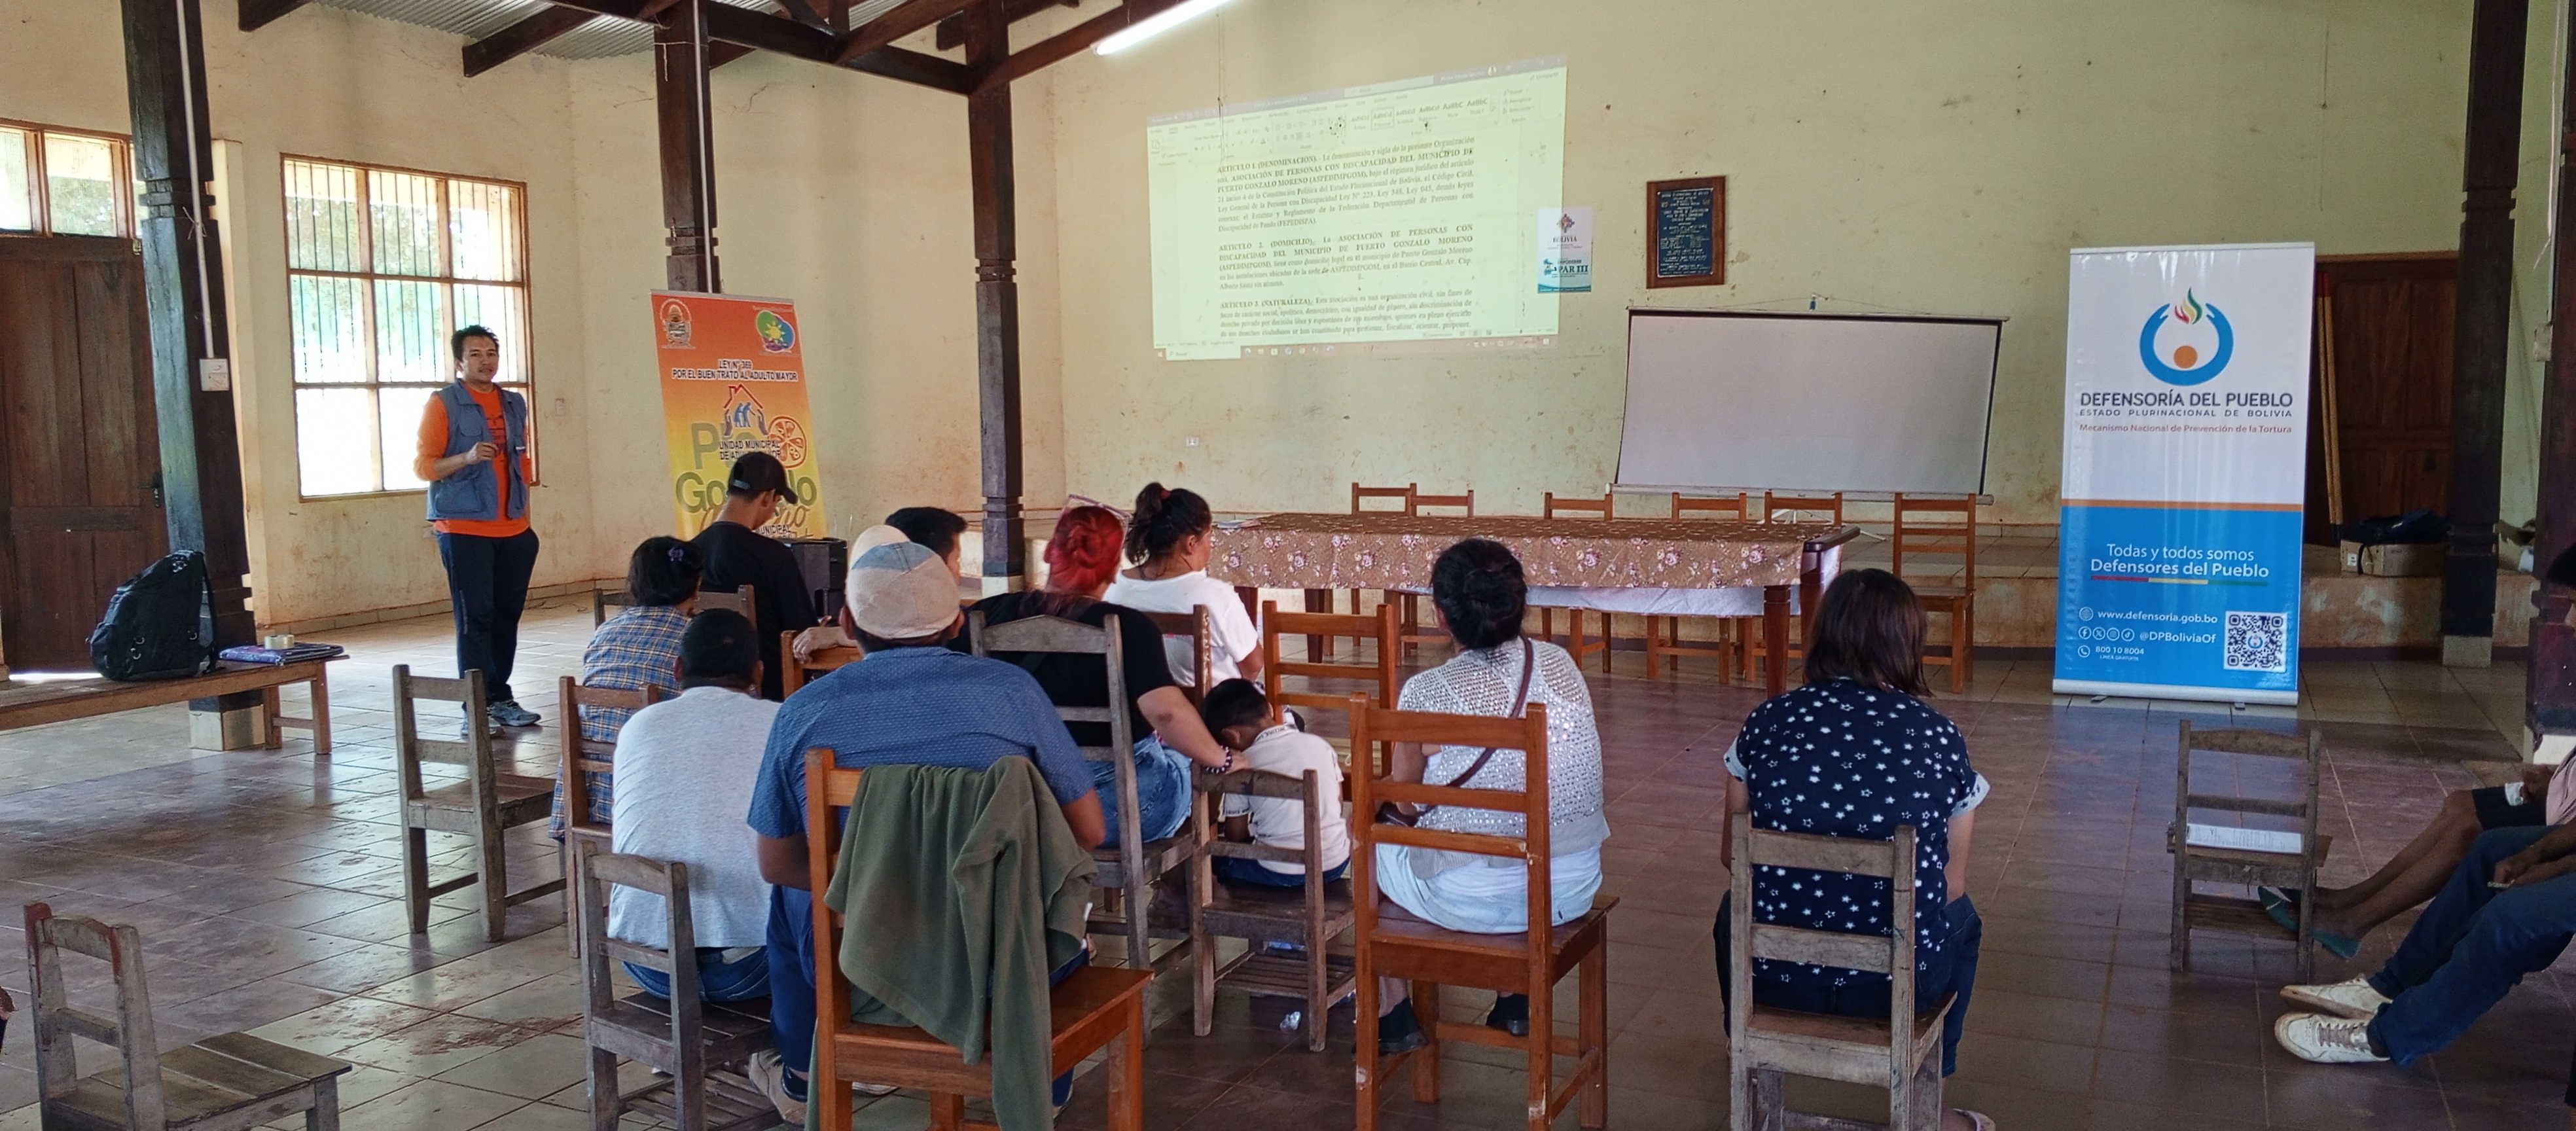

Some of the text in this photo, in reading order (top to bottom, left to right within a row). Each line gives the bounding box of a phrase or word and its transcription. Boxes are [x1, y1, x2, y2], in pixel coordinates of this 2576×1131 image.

[719, 360, 731, 368] LEY
[717, 370, 738, 379] TRATO
[2081, 389, 2293, 407] DEFENSORÍA DEL PUEBLO
[2184, 424, 2234, 433] Prevención
[720, 440, 781, 449] UNIDAD MUNICIPAL
[720, 452, 729, 460] DE
[2106, 543, 2255, 561] Todas y todos somos
[2091, 559, 2269, 578] Defensores del Pueblo
[2098, 611, 2218, 624] www.defensoria.gob.bo
[2139, 631, 2216, 643] @DPBoliviaOf
